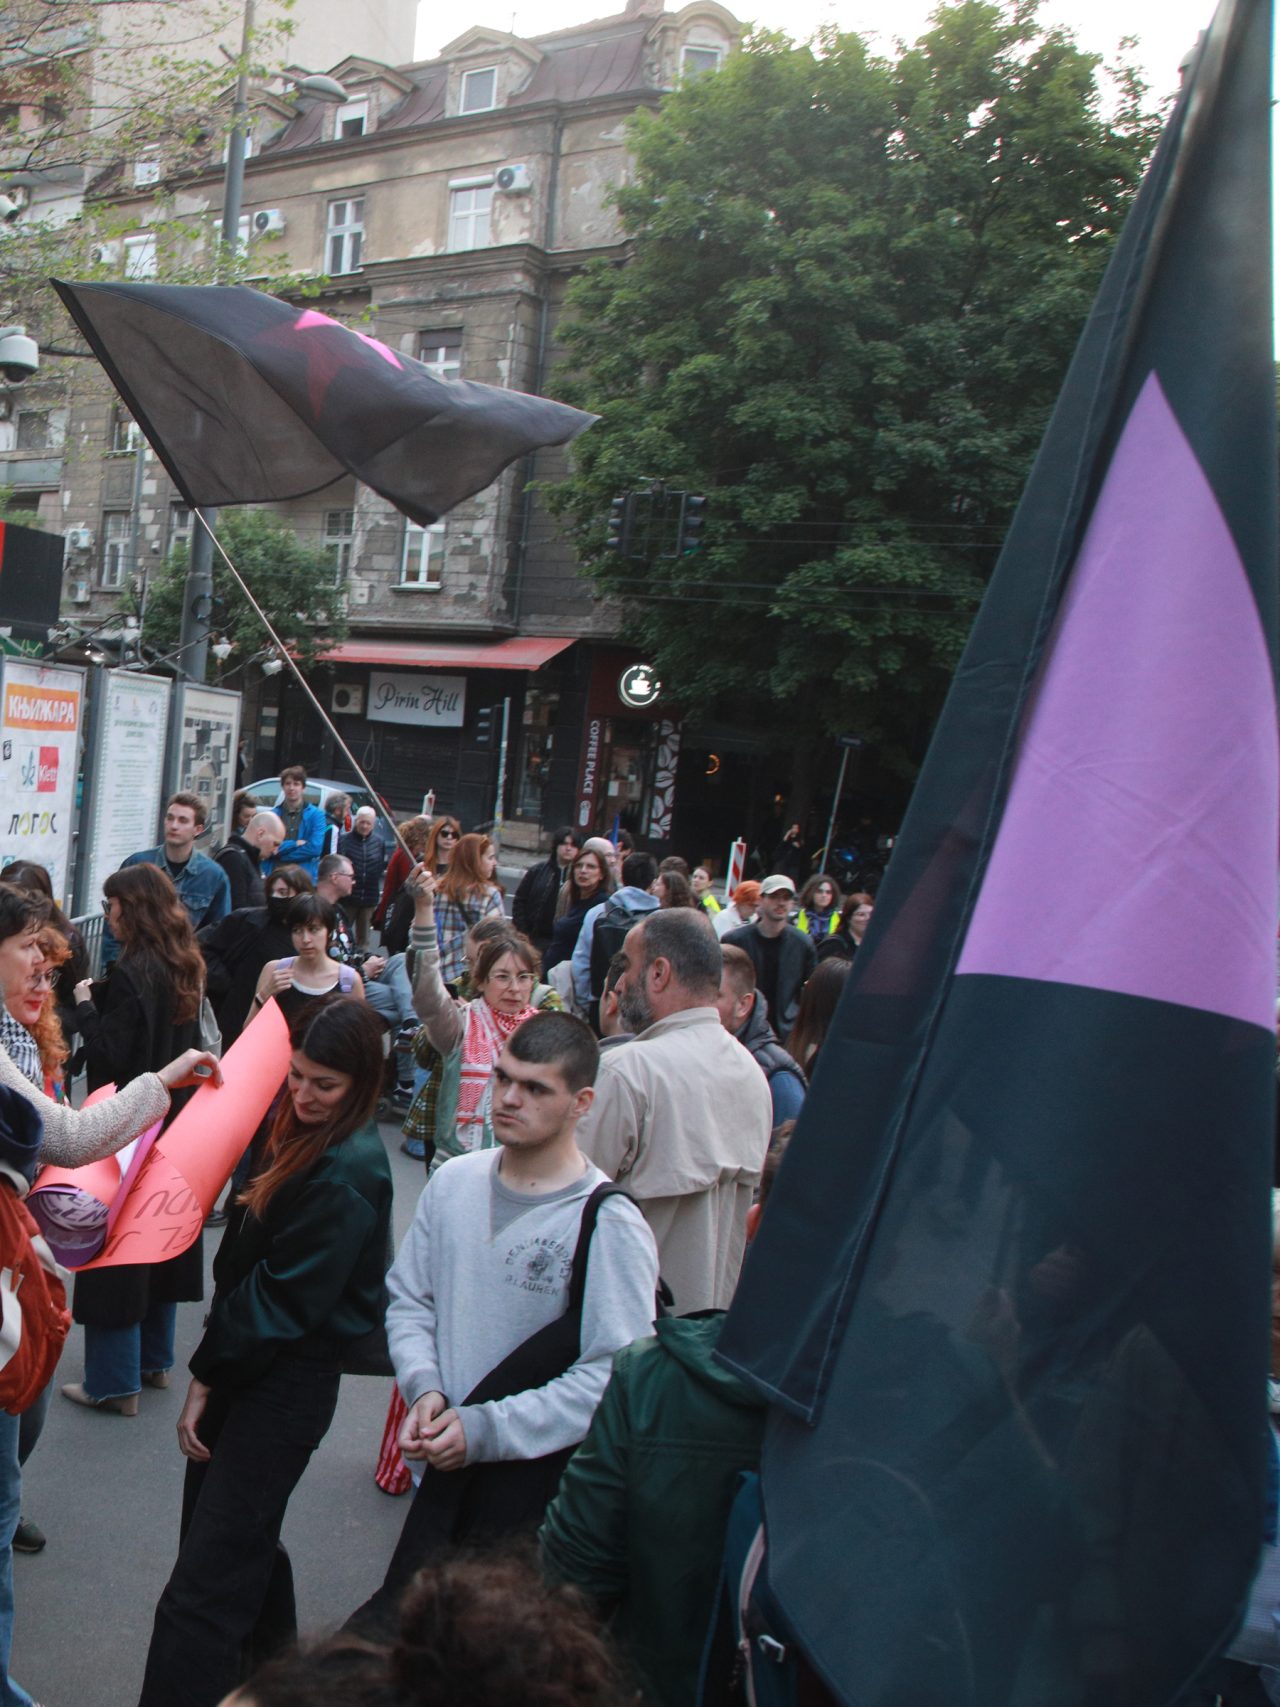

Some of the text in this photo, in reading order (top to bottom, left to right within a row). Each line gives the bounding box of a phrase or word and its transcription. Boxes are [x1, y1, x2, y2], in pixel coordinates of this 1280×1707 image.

[8, 695, 75, 724] КЊИЖАРА
[374, 682, 459, 715] Pirin Hill
[587, 720, 600, 759] COFFEE
[583, 761, 596, 794] PLACE
